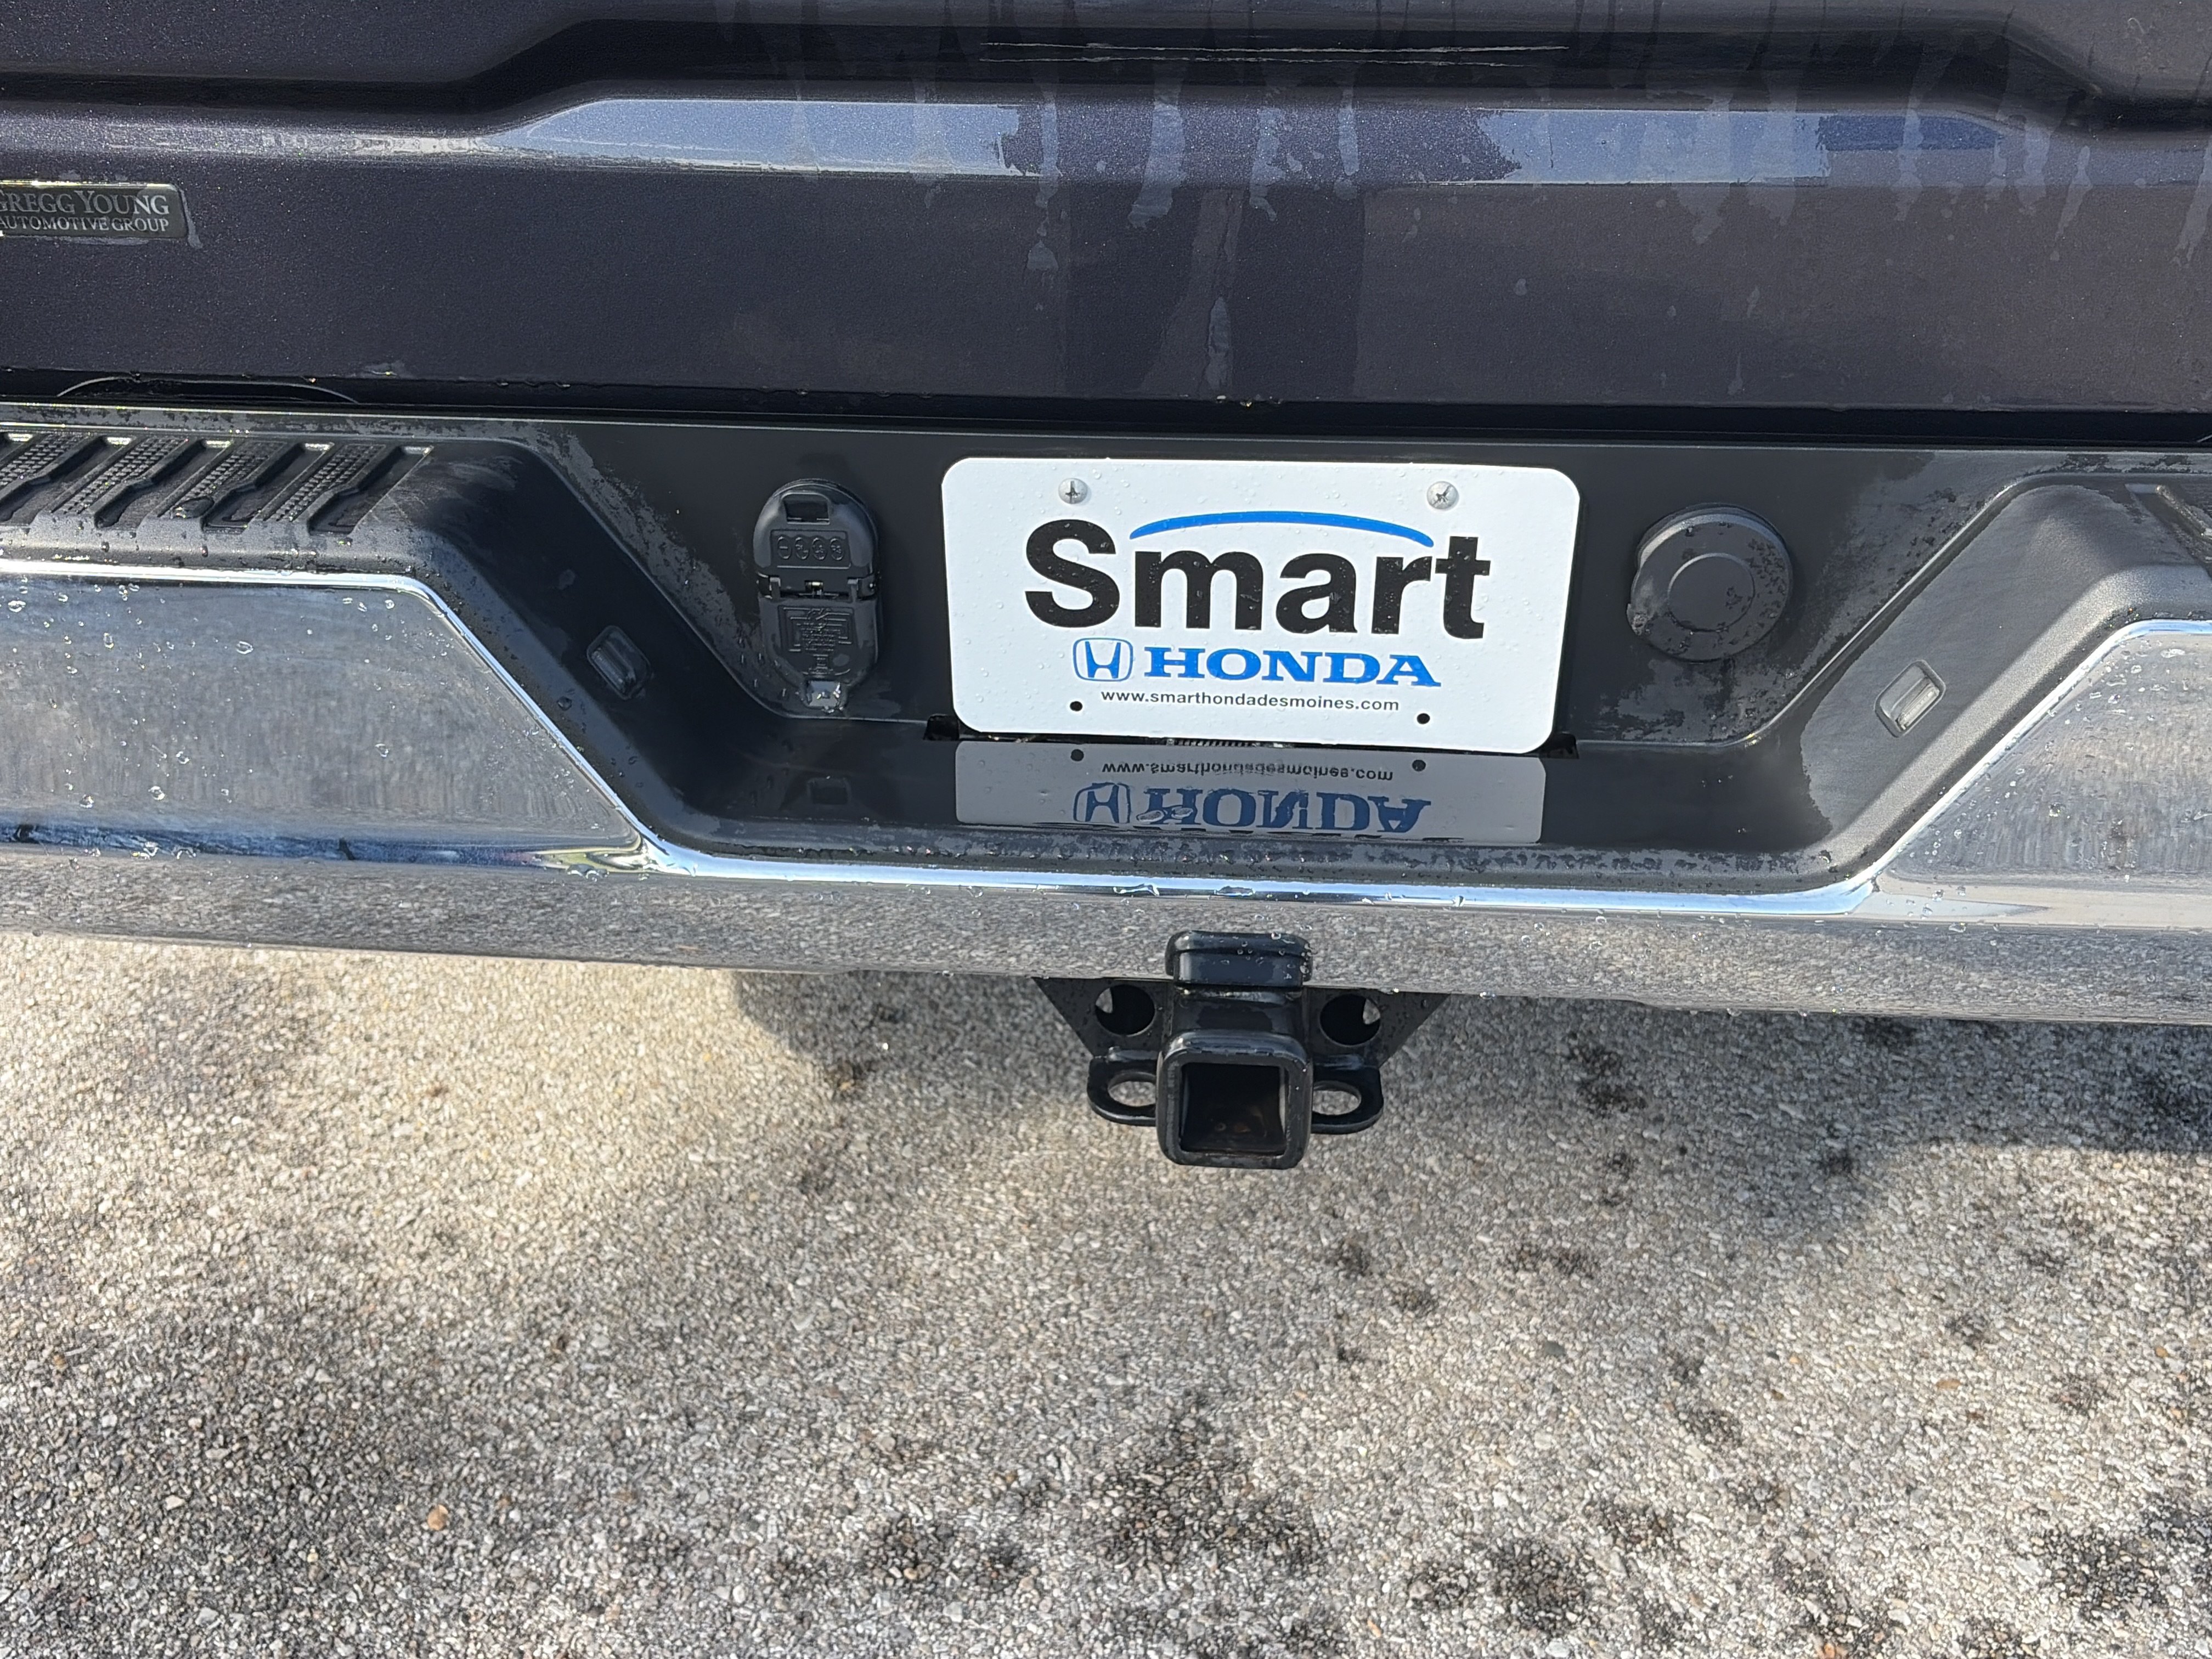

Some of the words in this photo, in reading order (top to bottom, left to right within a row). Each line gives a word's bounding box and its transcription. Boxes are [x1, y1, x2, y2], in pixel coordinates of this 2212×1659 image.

[74, 190, 170, 215] YOUNG
[111, 217, 169, 232] GROUP
[1025, 518, 1491, 640] Smart
[1144, 646, 1441, 687] HONDA
[1101, 691, 1399, 711] www.smarthondadesmoines.com
